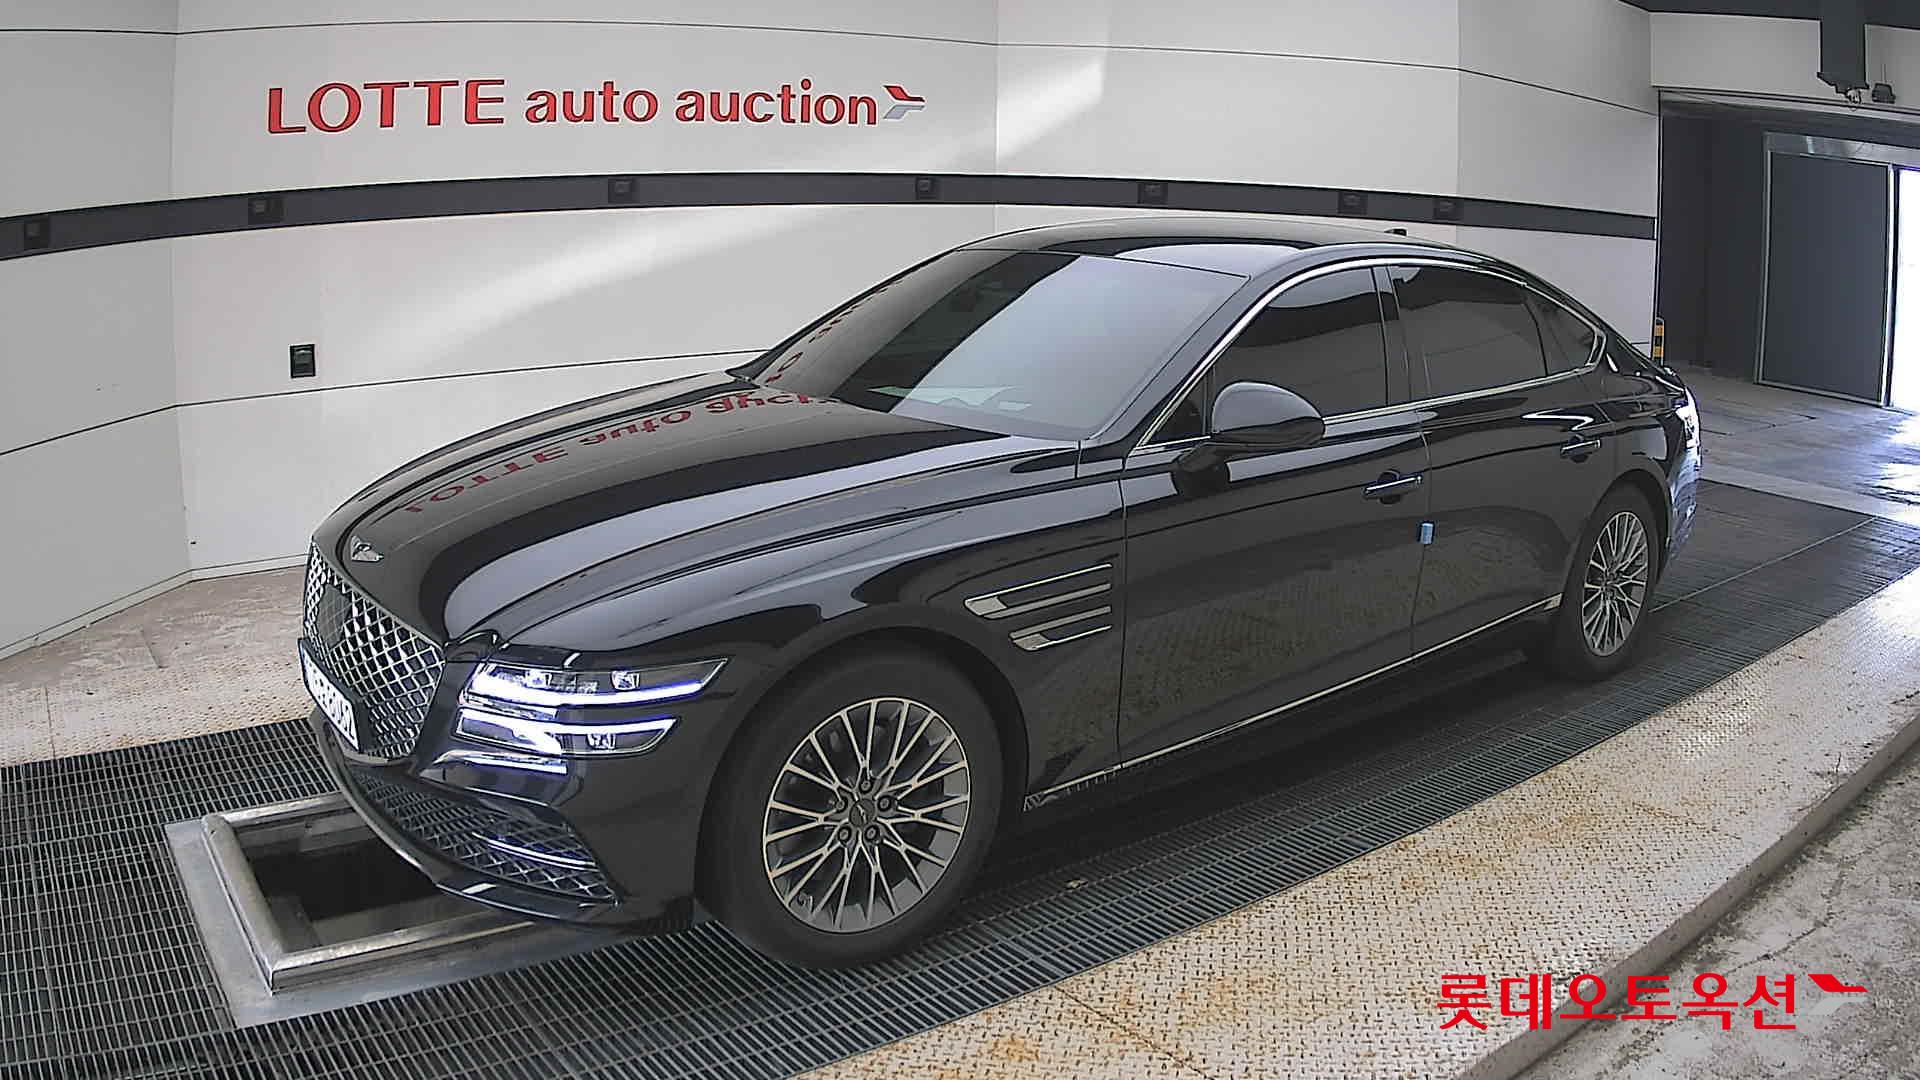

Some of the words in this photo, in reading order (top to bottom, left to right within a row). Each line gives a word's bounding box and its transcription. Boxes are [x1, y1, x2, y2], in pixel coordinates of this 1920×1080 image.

[268, 79, 505, 135] LOTTE
[524, 81, 660, 124] auto
[675, 78, 878, 126] auction
